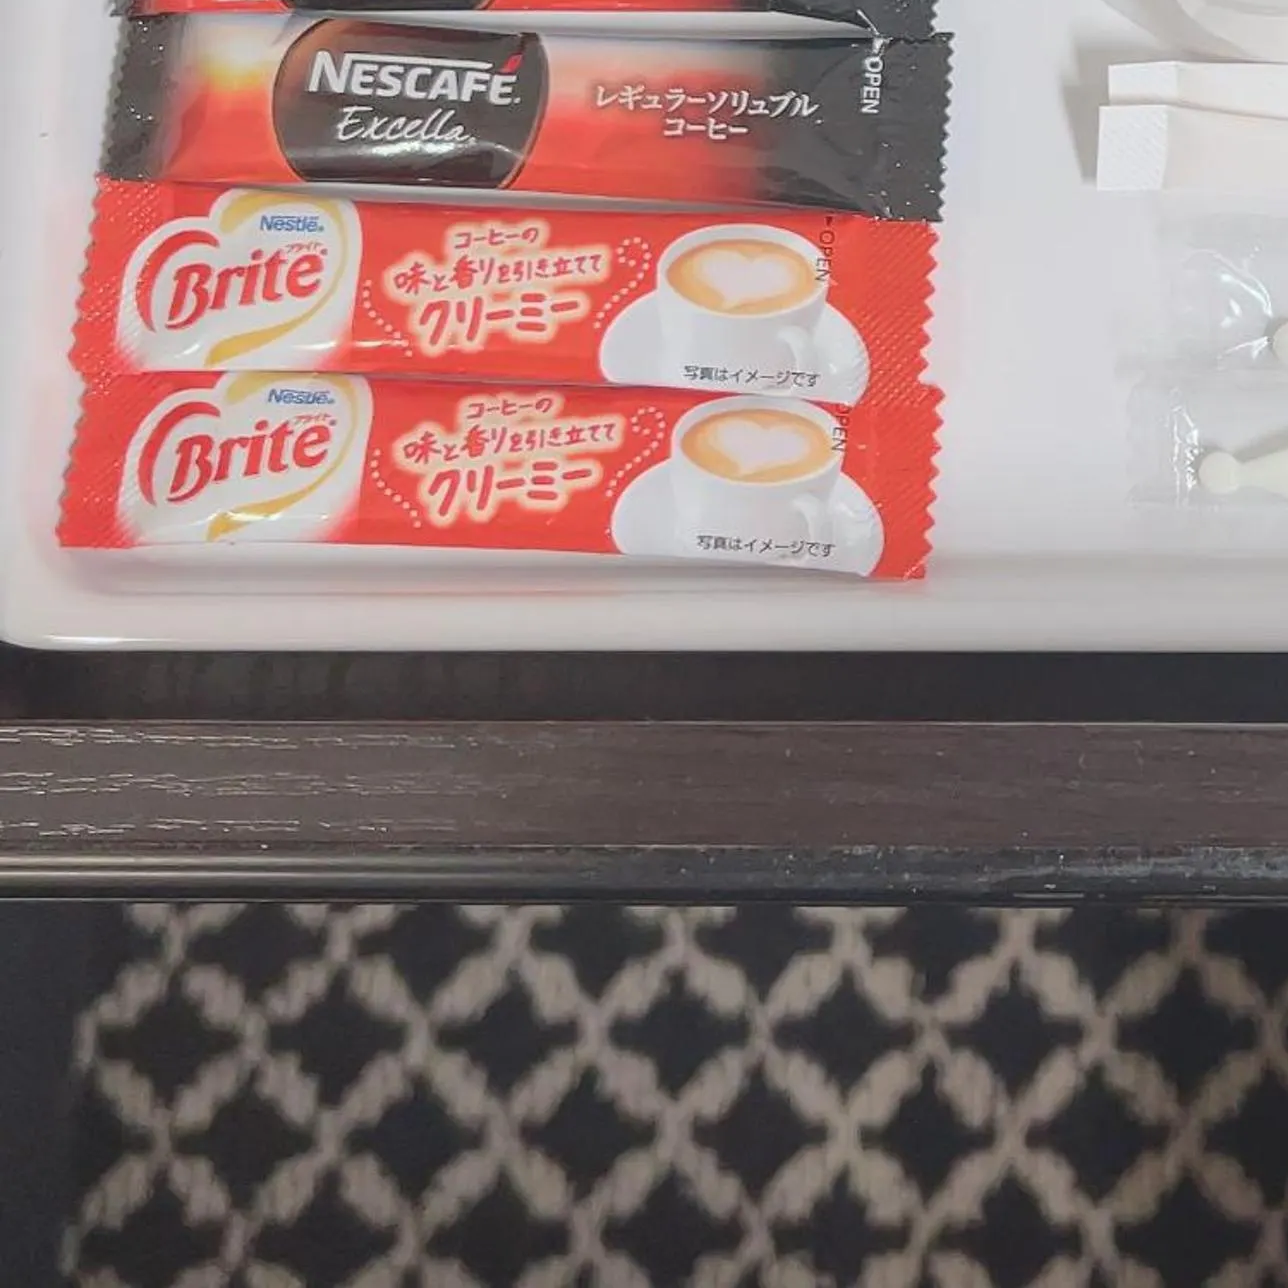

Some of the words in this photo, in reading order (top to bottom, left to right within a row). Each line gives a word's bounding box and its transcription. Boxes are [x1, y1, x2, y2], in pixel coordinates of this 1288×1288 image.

[860, 56, 884, 114] OPEN
[336, 106, 470, 144] Excella
[663, 117, 749, 140] コーヒー
[454, 227, 539, 249] コーヒーの
[815, 230, 836, 282] OPEN
[419, 292, 579, 346] クリーミー
[683, 365, 821, 388] 写真はイメージです
[467, 398, 552, 420] コーヒーの
[427, 462, 593, 517] クリーミー
[695, 534, 835, 559] 写真はイメージです
